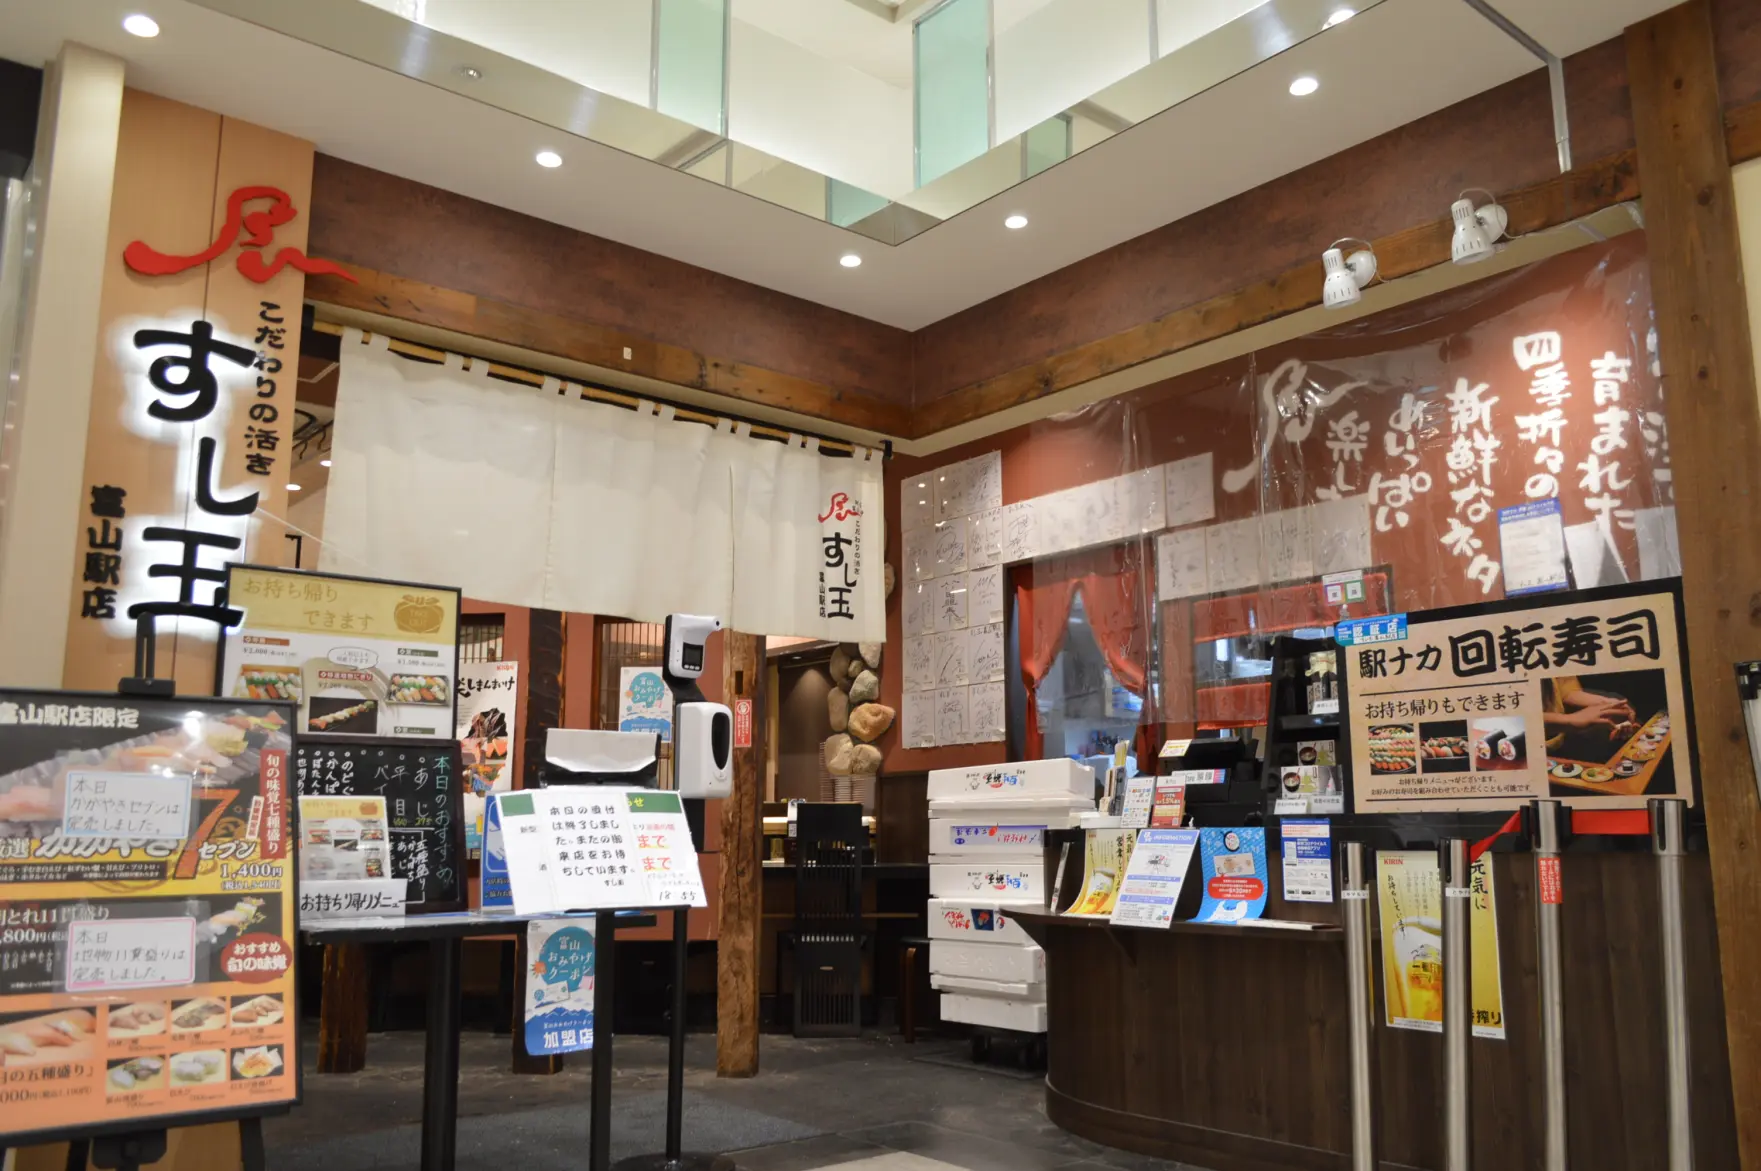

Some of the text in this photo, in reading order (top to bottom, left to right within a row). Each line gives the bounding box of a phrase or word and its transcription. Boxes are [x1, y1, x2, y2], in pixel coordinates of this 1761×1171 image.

[244, 301, 287, 476] こだわりの活き
[1512, 331, 1572, 500] 四季折々の
[1440, 376, 1503, 594] 新鮮なネタ
[81, 484, 127, 619] 富山駅店
[243, 577, 339, 603] お持ち帰り
[303, 609, 374, 631] できます
[1364, 691, 1526, 719] お持ち帰りもできます
[73, 777, 107, 794] 本日
[71, 797, 181, 815] かがやきセブンは
[266, 754, 280, 855] 旬の味覚七種盛り
[549, 805, 616, 816] 本日の受付
[433, 756, 454, 888] 本日のおすすめ
[551, 819, 620, 832] は終了しまし
[198, 841, 257, 860] セブン
[558, 848, 626, 861] 来店をお待
[220, 862, 283, 881] 1,400円
[1470, 859, 1489, 911] 元気に
[300, 890, 406, 913] お持ち帰りメニュー
[76, 930, 108, 944] 本日
[558, 935, 581, 951] 富山
[233, 942, 281, 956] おすすめ
[547, 951, 594, 967] おみやげ
[549, 965, 592, 981] クーポン
[1472, 1008, 1502, 1025] 搾り
[543, 1027, 594, 1050] 加盟店
